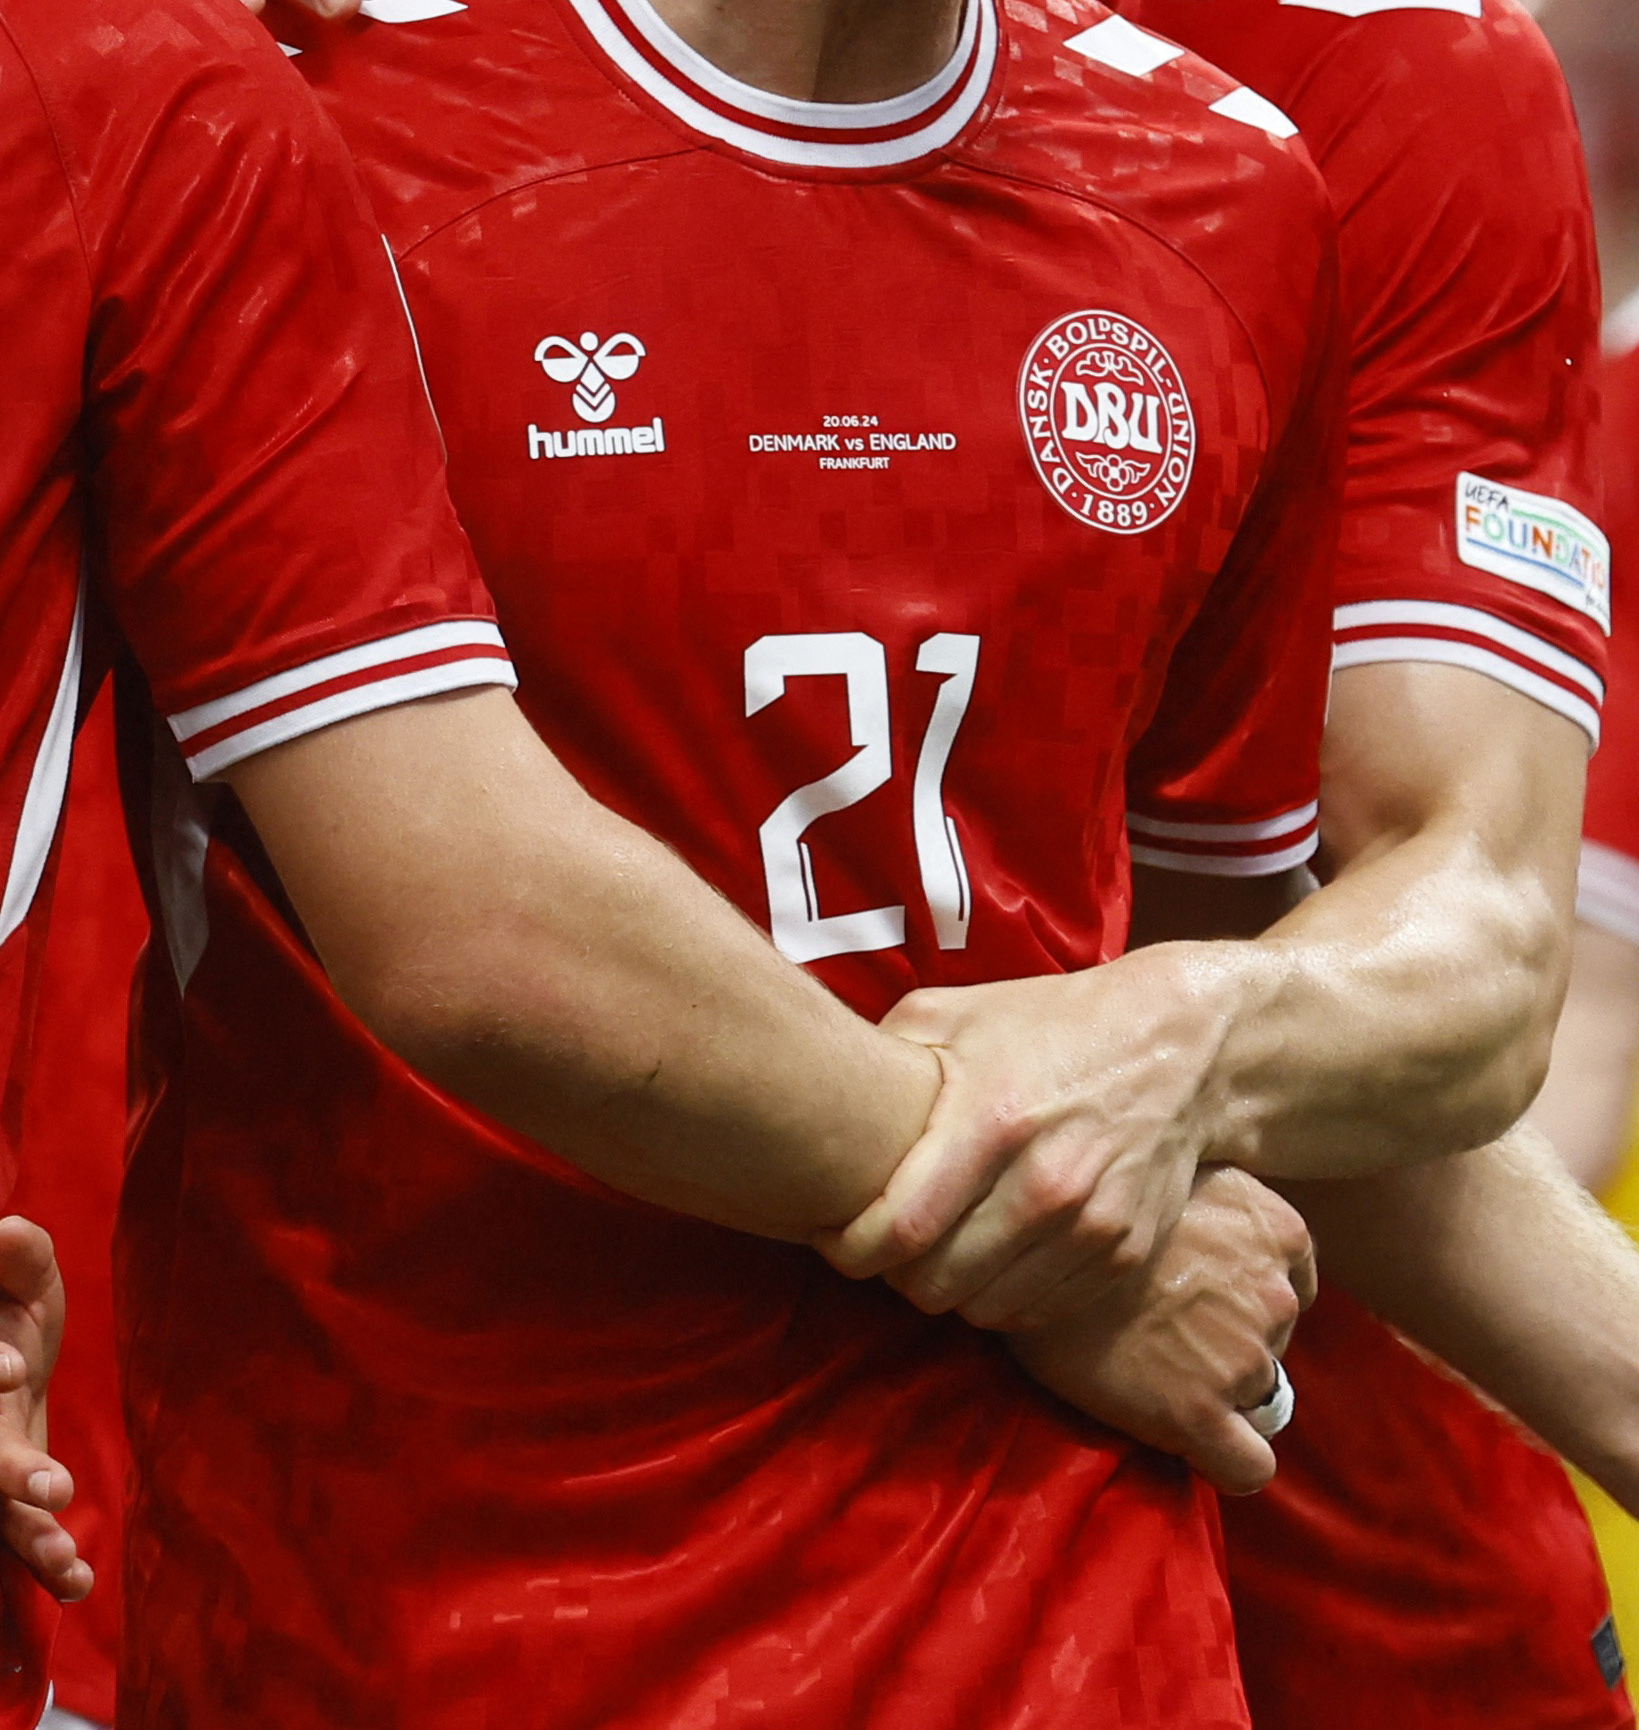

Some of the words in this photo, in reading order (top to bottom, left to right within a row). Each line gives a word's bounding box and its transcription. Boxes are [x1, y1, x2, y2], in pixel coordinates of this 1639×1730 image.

[822, 415, 879, 427] 20.06.24
[1027, 362, 1074, 494] DANSK
[1061, 381, 1163, 454] DBU
[527, 416, 666, 460] hummel
[748, 433, 840, 452] DENMARK
[844, 437, 865, 451] vs
[868, 432, 957, 451] ENGLAND
[818, 456, 890, 470] FRANKFURT
[1079, 493, 1148, 527] 1889
[1464, 481, 1509, 510] UEFA
[744, 632, 982, 964] 21
